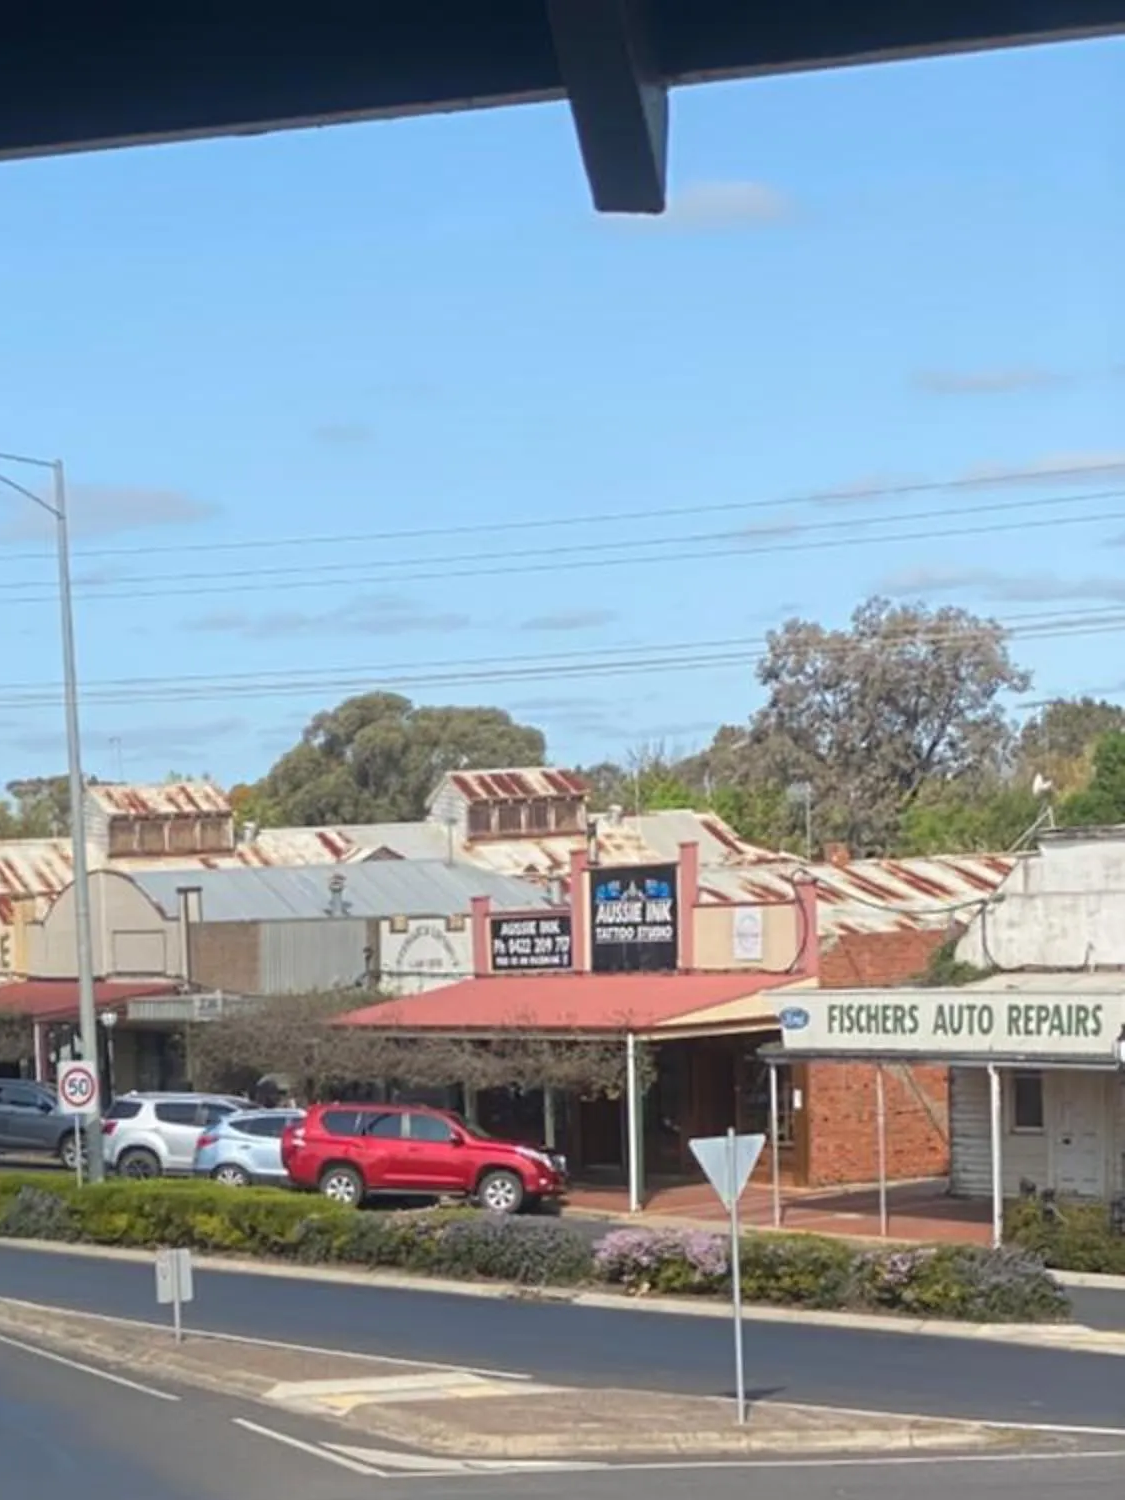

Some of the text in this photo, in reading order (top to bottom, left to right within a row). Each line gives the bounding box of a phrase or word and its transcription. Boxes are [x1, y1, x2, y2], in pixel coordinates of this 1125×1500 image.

[596, 899, 672, 923] AUSSIE INK
[827, 1004, 919, 1035] FISCHERS
[932, 1004, 994, 1035] AUTO
[1007, 1004, 1103, 1036] REPAIRS
[68, 1077, 90, 1097] 50
